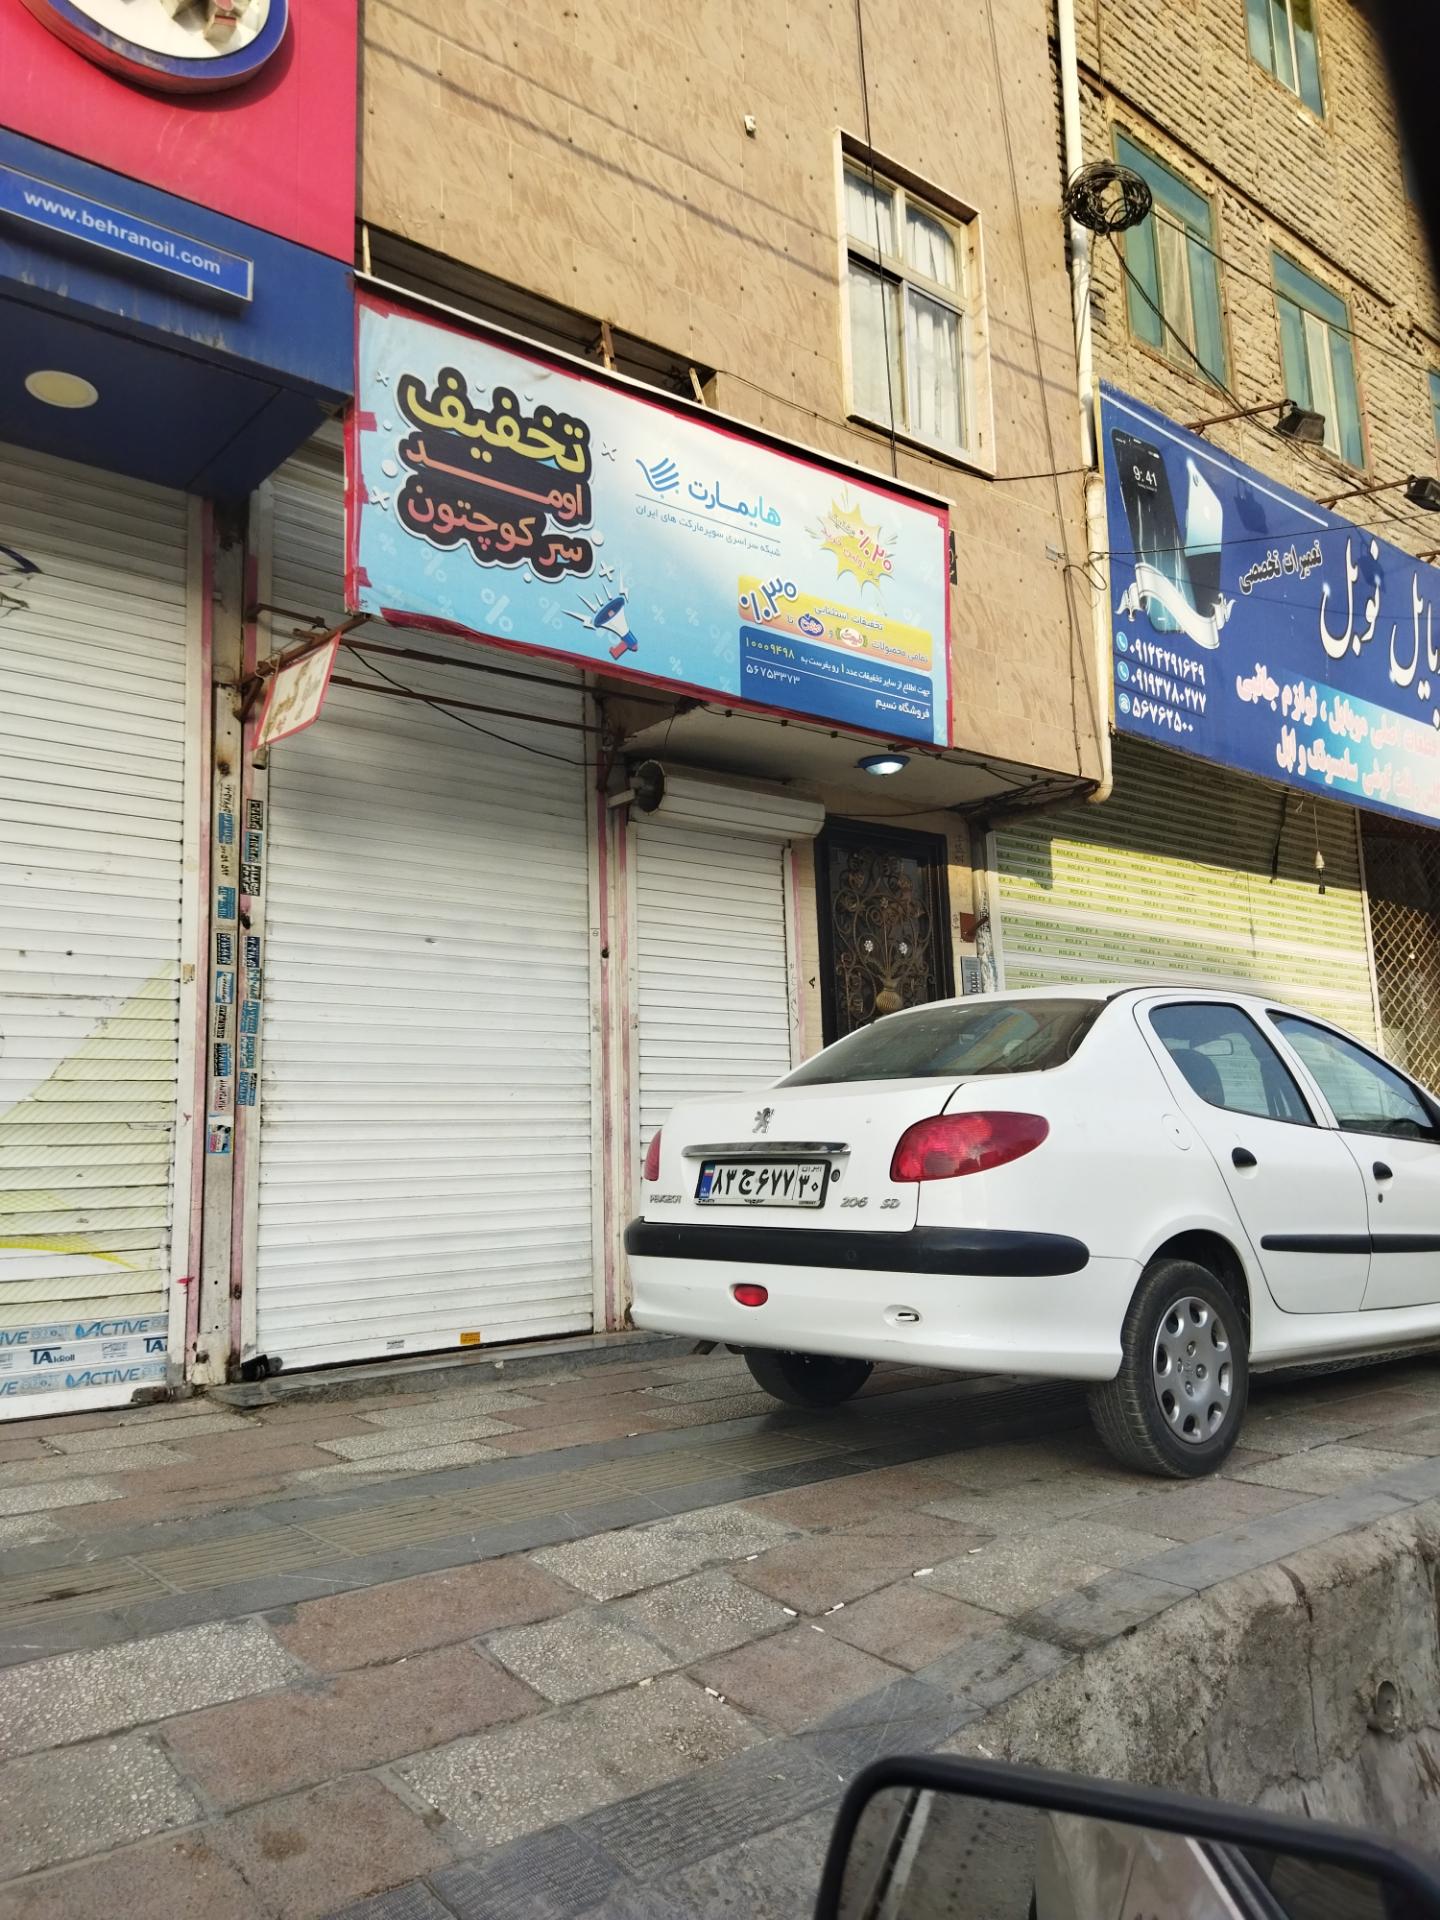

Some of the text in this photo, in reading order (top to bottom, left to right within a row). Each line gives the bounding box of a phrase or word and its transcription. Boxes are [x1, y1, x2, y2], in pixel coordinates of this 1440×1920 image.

[23, 191, 221, 275] www.behranoil.com
[406, 376, 587, 474] تخفیف
[1132, 465, 1157, 487] 9:41
[635, 504, 658, 519] ایران
[660, 512, 677, 524] های
[407, 484, 583, 567] سر کوچتون
[725, 534, 759, 550] سراسری
[759, 543, 781, 557] شبکه
[1238, 539, 1323, 595] تعمیرات تخصصی
[1320, 538, 1381, 659] نوبل
[871, 640, 906, 658] محصولات
[845, 668, 858, 677] عدد
[882, 677, 897, 688] سایر
[917, 687, 931, 697] جهت
[1236, 662, 1280, 712] جانبی
[875, 699, 897, 711] نسیم
[898, 702, 931, 719] فروشگاه
[1132, 696, 1194, 733] ۵۶۷۶۲۵۰۰
[1281, 681, 1318, 726] لوازم
[1276, 724, 1297, 774] اپل
[1297, 744, 1307, 776] و
[1307, 738, 1358, 785] سامسونگ
[840, 1197, 900, 1210] 206 SD
